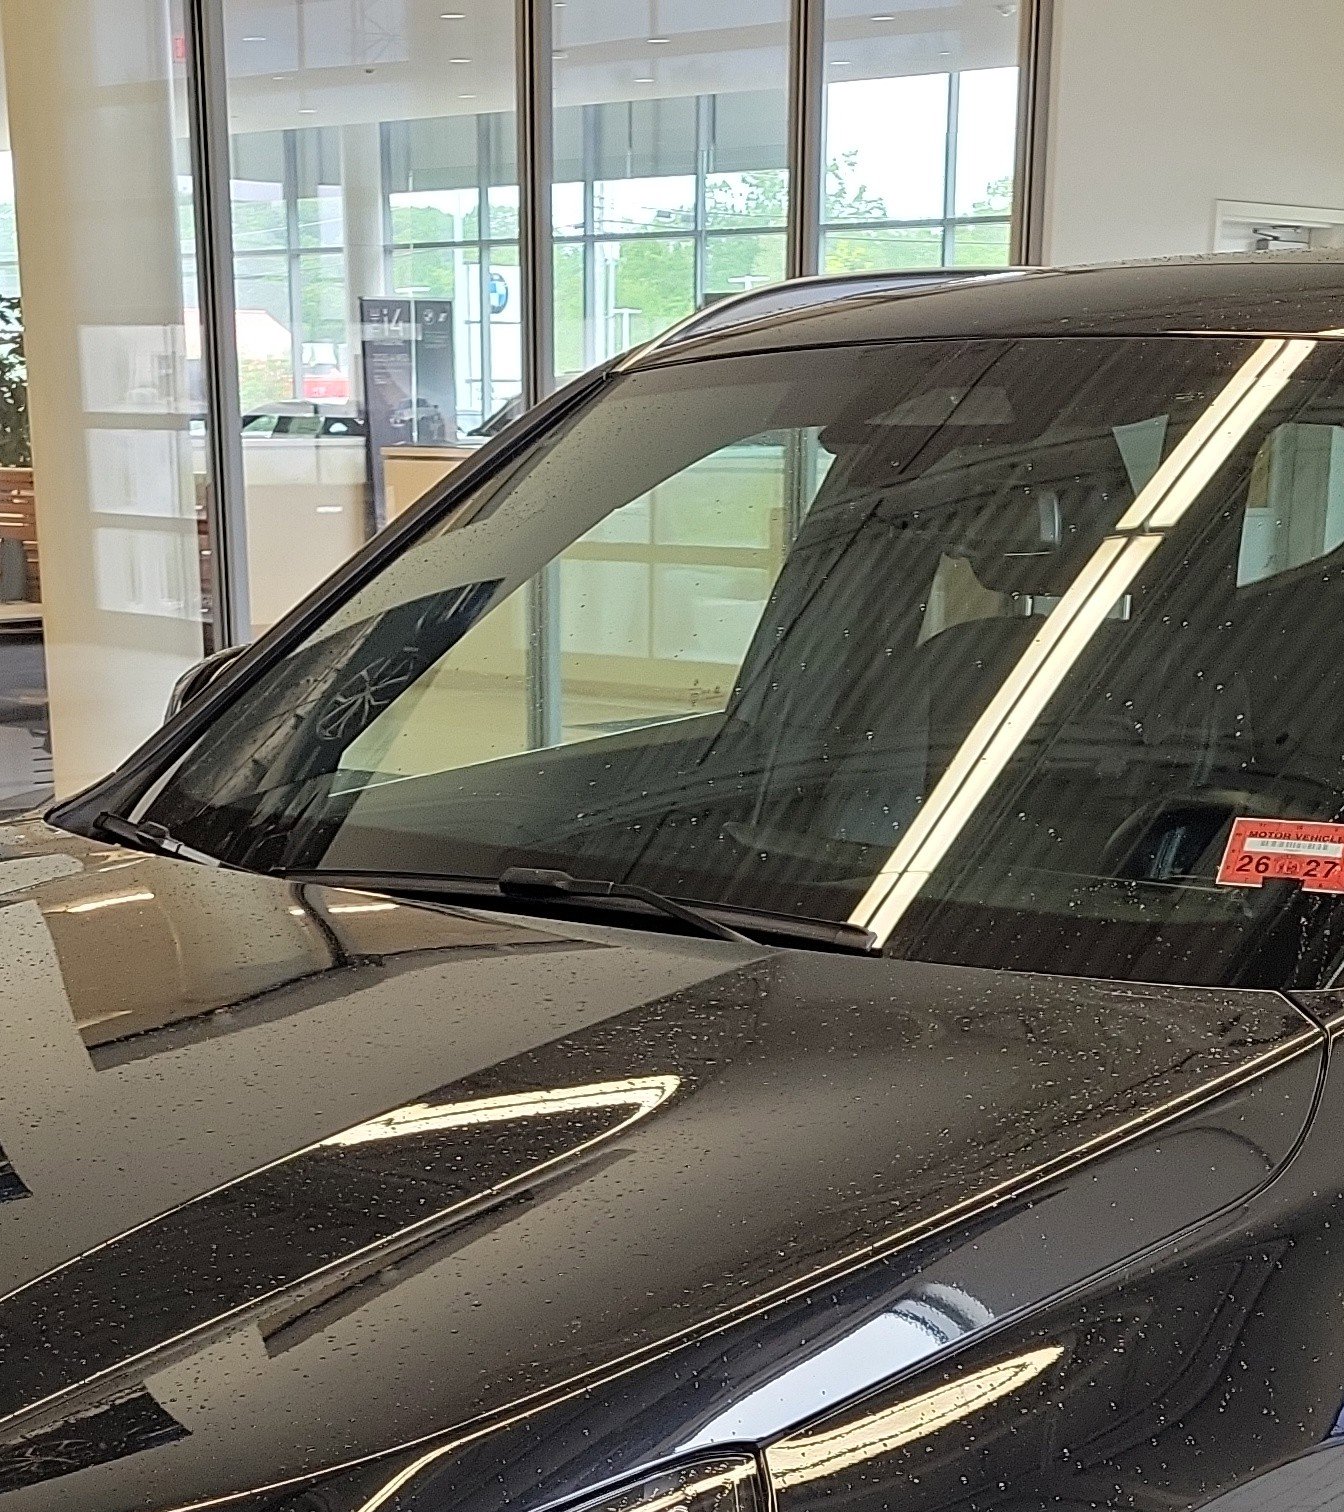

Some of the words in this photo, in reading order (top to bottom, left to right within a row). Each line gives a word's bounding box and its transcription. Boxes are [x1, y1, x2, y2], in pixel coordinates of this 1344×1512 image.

[1248, 830, 1292, 841] MOTOR
[1235, 854, 1271, 874] 26
[1302, 859, 1341, 879] 27
